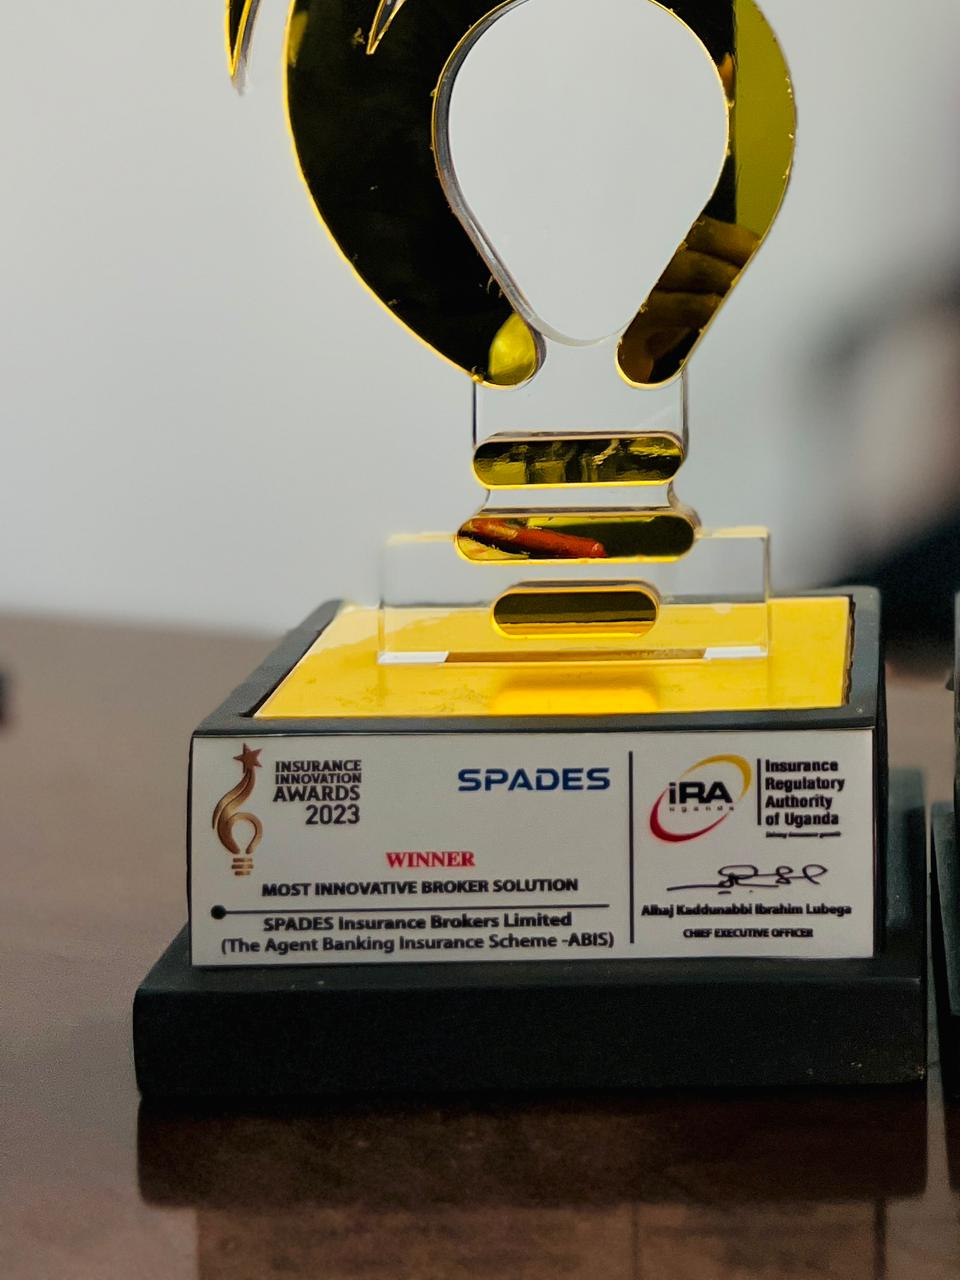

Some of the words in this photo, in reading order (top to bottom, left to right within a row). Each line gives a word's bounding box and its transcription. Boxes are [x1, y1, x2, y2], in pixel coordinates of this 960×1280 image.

[275, 760, 362, 772] INSURANCE
[765, 760, 839, 772] Insurance
[275, 772, 362, 784] INNOVATION
[458, 768, 610, 792] SPADES
[765, 777, 845, 792] Regulatory
[273, 785, 360, 802] AWARDS
[765, 794, 833, 810] Authority
[305, 804, 360, 825] 2023
[766, 812, 780, 826] of
[784, 813, 839, 828] Uganda
[386, 852, 475, 868] WINNER
[262, 882, 312, 896] MOST
[315, 881, 418, 896] INNOVATIVE
[421, 880, 489, 894] BROKER
[493, 878, 578, 893] SOLUTION
[642, 904, 674, 918] Alhaj
[676, 904, 752, 916] Kaddunabbi
[755, 904, 804, 915] Ibrahim
[806, 904, 852, 917] Lubega
[263, 916, 334, 932] SPADES
[339, 916, 426, 930] Insurance
[430, 914, 500, 929] Brokers
[503, 912, 572, 928] Limited
[683, 928, 712, 938] CHIEF
[714, 928, 770, 938] EXECUTIVE
[772, 928, 814, 938] OFFICER
[221, 938, 260, 954] (The
[264, 938, 319, 956] Agent
[322, 936, 394, 954] Banking
[399, 934, 485, 950] Insurance
[489, 934, 557, 949] Scheme
[561, 932, 614, 948] -ABIS)
